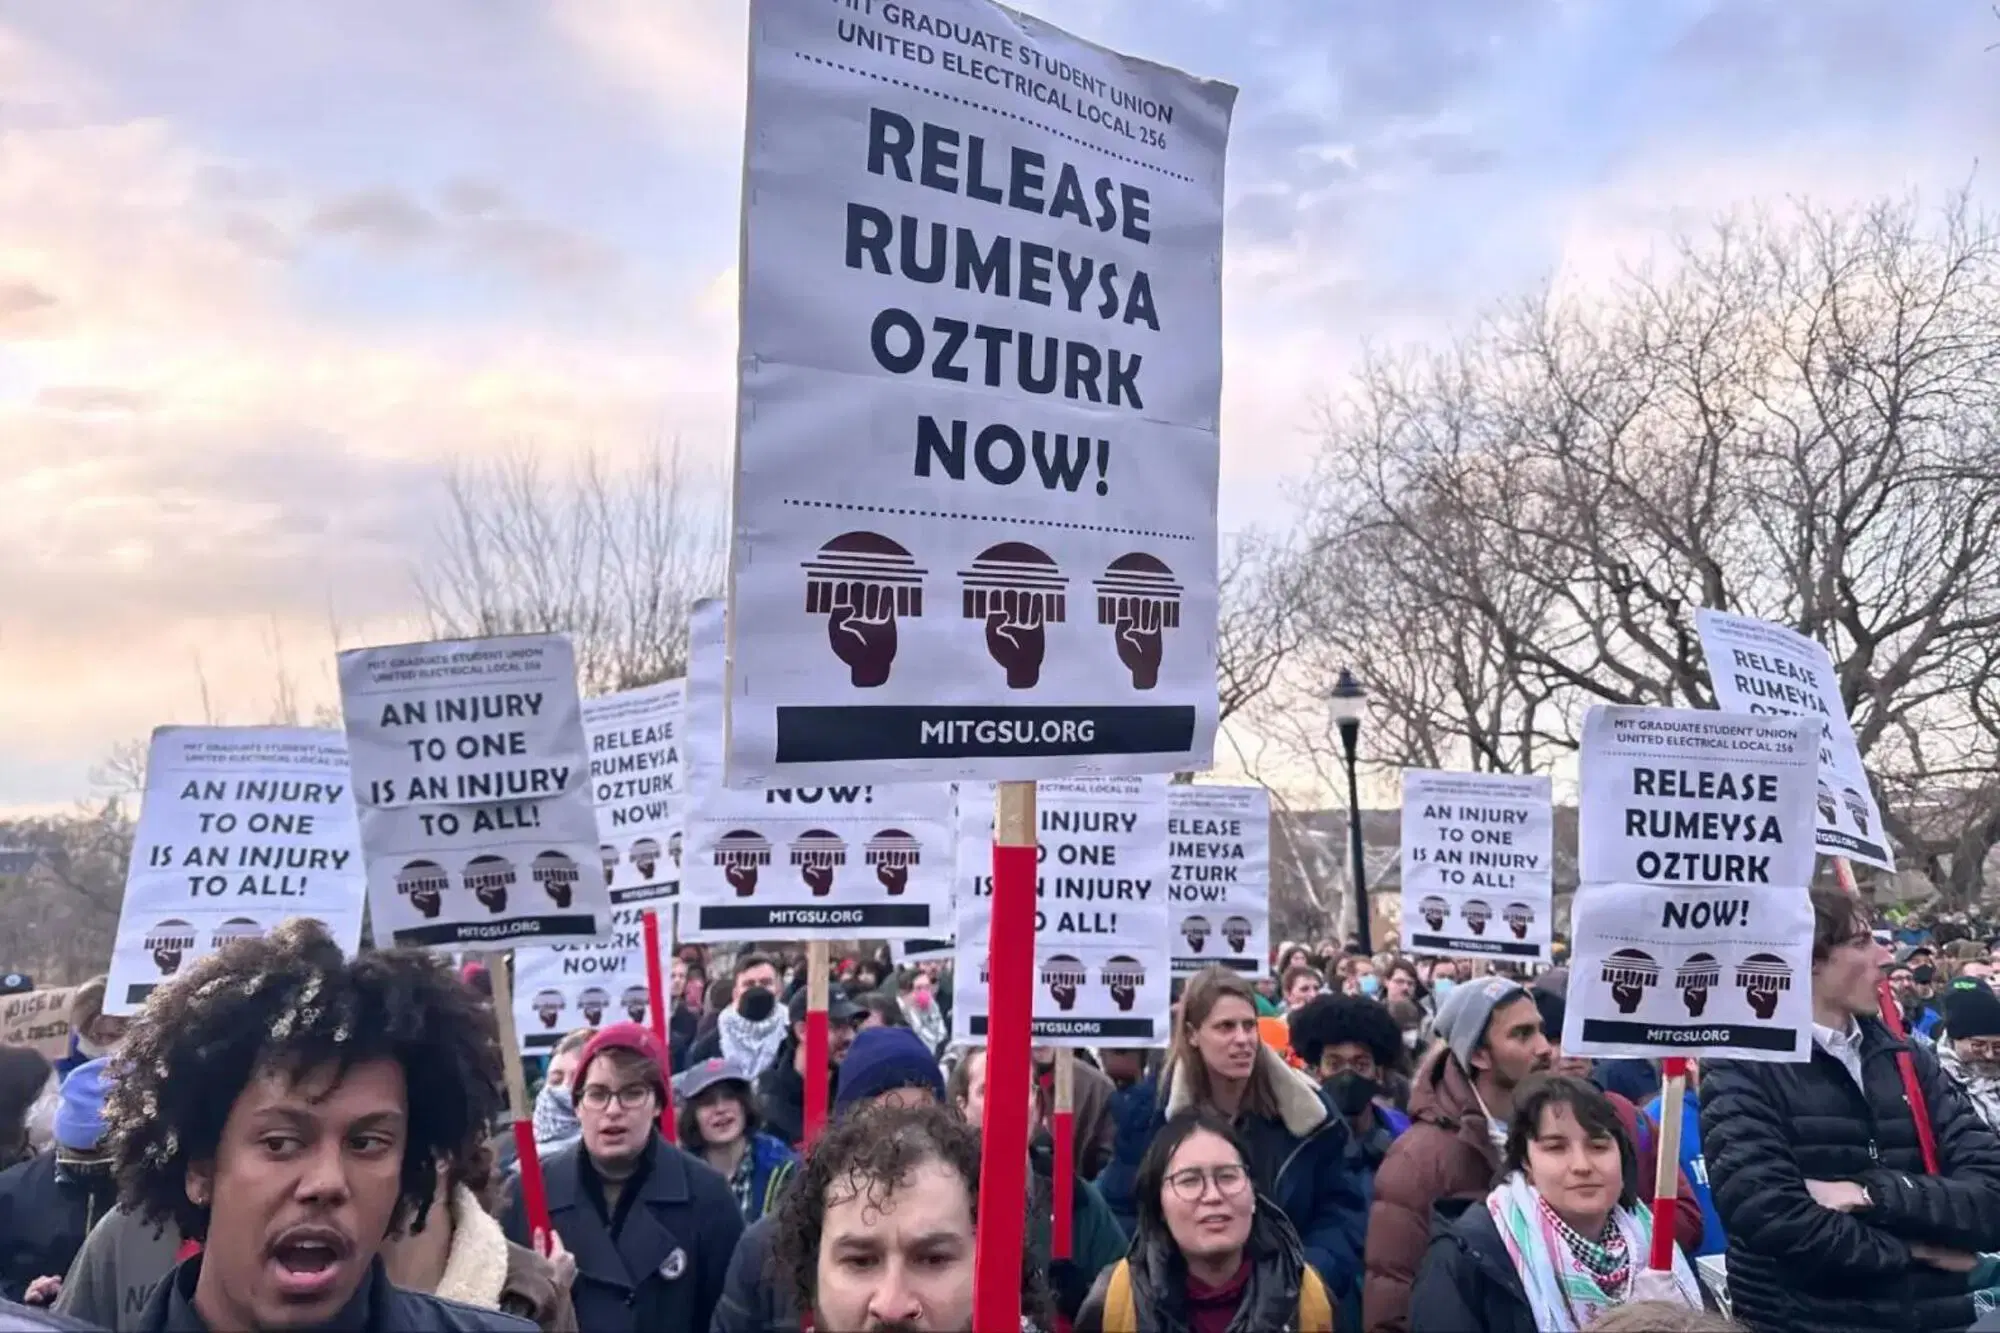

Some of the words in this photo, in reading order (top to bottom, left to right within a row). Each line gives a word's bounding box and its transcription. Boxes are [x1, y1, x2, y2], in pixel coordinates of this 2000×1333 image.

[883, 4, 1012, 58] GRADUATE
[1018, 46, 1106, 97] STUDENT
[1111, 86, 1173, 124] UNION
[838, 19, 934, 66] UNITED
[943, 52, 1072, 113] ELECTRICAL
[1077, 99, 1135, 139] LOCAL
[1140, 126, 1166, 150] 256
[867, 107, 1151, 244] RELEASE
[845, 202, 1160, 331] RUMEYSA
[871, 308, 1143, 409] OZTURK
[914, 415, 1110, 496] NOW!
[1732, 648, 1819, 688] RELEASE
[1734, 674, 1831, 717] RUMEYSA
[380, 701, 427, 728] AN
[436, 692, 543, 723] INJURY
[593, 722, 674, 752] RELEASE
[921, 719, 1095, 744] MITGSU.ORG
[1615, 719, 1635, 729] MIT
[1639, 722, 1700, 733] GRADUATE
[1703, 724, 1753, 736] STUDENT
[1756, 728, 1797, 738] UNION
[408, 738, 445, 762] TO
[456, 732, 526, 759] ONE
[1617, 733, 1663, 745] UNITED
[1667, 737, 1728, 749] ELECTRICAL
[1733, 741, 1772, 751] LOCAL
[590, 747, 678, 778] RUMEYSA
[181, 781, 226, 800] AN
[235, 781, 343, 804] INJURY
[371, 780, 395, 804] IS
[408, 776, 448, 801] AN
[457, 767, 569, 798] INJURY
[597, 773, 674, 801] OZTURK
[1634, 768, 1778, 802] RELEASE
[199, 813, 236, 833] TO
[248, 813, 314, 834] ONE
[420, 813, 459, 836] TO
[472, 805, 541, 833] ALL!
[612, 801, 669, 826] NOW!
[1041, 811, 1137, 834] INJURY
[1423, 805, 1452, 820] AN
[1459, 807, 1528, 824] INJURY
[1625, 809, 1782, 843] RUMEYSA
[1168, 819, 1241, 836] ELEASE
[1439, 827, 1463, 842] TO
[1471, 830, 1512, 845] ONE
[150, 846, 173, 867] IS
[183, 846, 229, 867] AN
[239, 847, 349, 870] INJURY
[1058, 844, 1116, 865] ONE
[1169, 841, 1244, 860] MEYSA
[1413, 848, 1426, 861] IS
[1434, 849, 1462, 864] AN
[1470, 852, 1538, 869] INJURY
[1171, 865, 1237, 881] ZTURK
[1441, 870, 1464, 884] TO
[1472, 873, 1515, 888] ALL!
[1637, 851, 1771, 883] OZTURK
[189, 876, 228, 896] TO
[238, 876, 307, 896] ALL!
[974, 876, 993, 896] IS
[1055, 879, 1152, 901] INJURY
[1168, 885, 1226, 901] NOW!
[770, 911, 863, 923] MITGSU.ORG
[1058, 913, 1117, 933] ALL!
[1662, 900, 1749, 929] NOW!
[564, 956, 626, 974] NOW!
[1647, 1029, 1730, 1042] MITGSU.ORG
